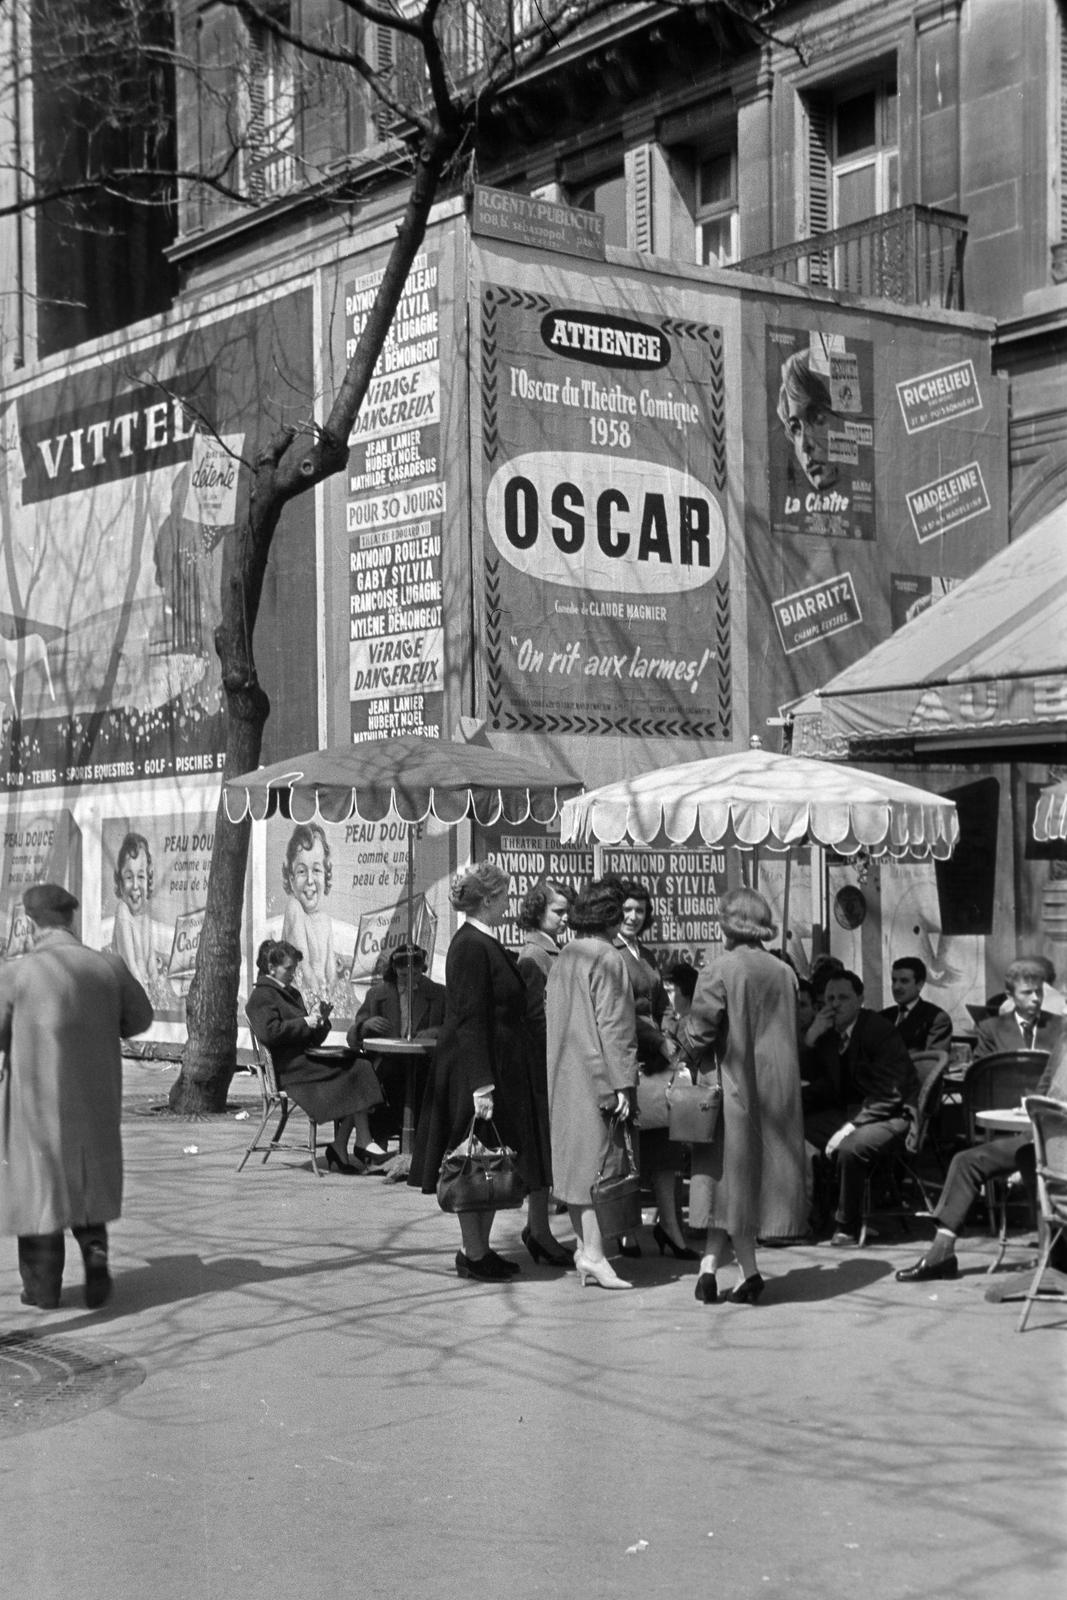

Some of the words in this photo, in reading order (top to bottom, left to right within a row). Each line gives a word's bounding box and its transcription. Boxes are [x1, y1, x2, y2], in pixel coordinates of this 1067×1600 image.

[346, 288, 379, 316] RAYMO
[401, 266, 437, 298] OULEAU
[393, 292, 429, 322] YLVIA
[397, 311, 438, 342] LUGAGNE
[903, 368, 970, 407] RICHELIEU
[352, 390, 435, 435] DANGEREUX
[562, 376, 580, 407] du
[640, 388, 699, 430] Comique
[37, 398, 198, 479] VITTEL
[365, 438, 388, 458] JEAN
[391, 430, 421, 451] LANIER
[590, 416, 631, 448] 1958
[351, 470, 386, 492] MATHILDE
[388, 457, 437, 482] CASADESUS
[365, 451, 397, 472] HUBERT
[784, 496, 801, 515] La
[805, 490, 849, 512] Chatte
[912, 470, 978, 514] MADELEINE
[350, 503, 379, 527] POUR
[382, 498, 400, 520] 30
[403, 487, 443, 515] JOURS
[504, 475, 710, 567] OSCAR
[350, 546, 392, 572] RAYMOND
[395, 536, 440, 563] ROULEAU
[357, 568, 387, 591] GABY
[391, 560, 433, 585] SYLVIA
[401, 580, 442, 606] LUGAGNE
[780, 583, 850, 627] BIARRITZ
[590, 601, 624, 618] CLAUDE
[627, 604, 667, 622] MAGNIER
[548, 641, 580, 674] rit
[584, 654, 626, 679] aux
[354, 658, 439, 691] DANGEREUX
[368, 698, 390, 715] JEAN
[393, 695, 424, 712] LANIER
[368, 713, 400, 731] HUBERT
[31, 769, 57, 785] TENNIS
[144, 758, 165, 774] GOLF
[176, 754, 213, 772] PISCINES
[4, 832, 23, 848] PEAU
[26, 830, 55, 846] DOUCE
[165, 834, 189, 852] PEAU
[192, 833, 214, 851] DOU
[345, 823, 376, 843] PEAU
[174, 860, 199, 872] comme
[358, 851, 389, 864] comme
[488, 852, 545, 873] RAYMOND
[611, 854, 665, 873] RAYMOND
[670, 854, 725, 874] ROULEAU
[170, 879, 188, 895] peau
[190, 876, 200, 891] de
[352, 873, 376, 888] peau
[379, 870, 390, 885] de
[507, 875, 539, 895] ABY
[665, 876, 716, 895] SYLVIA
[678, 897, 721, 916] LUGAGN
[177, 931, 201, 953] Cad
[662, 921, 721, 941] DEMONGEO
